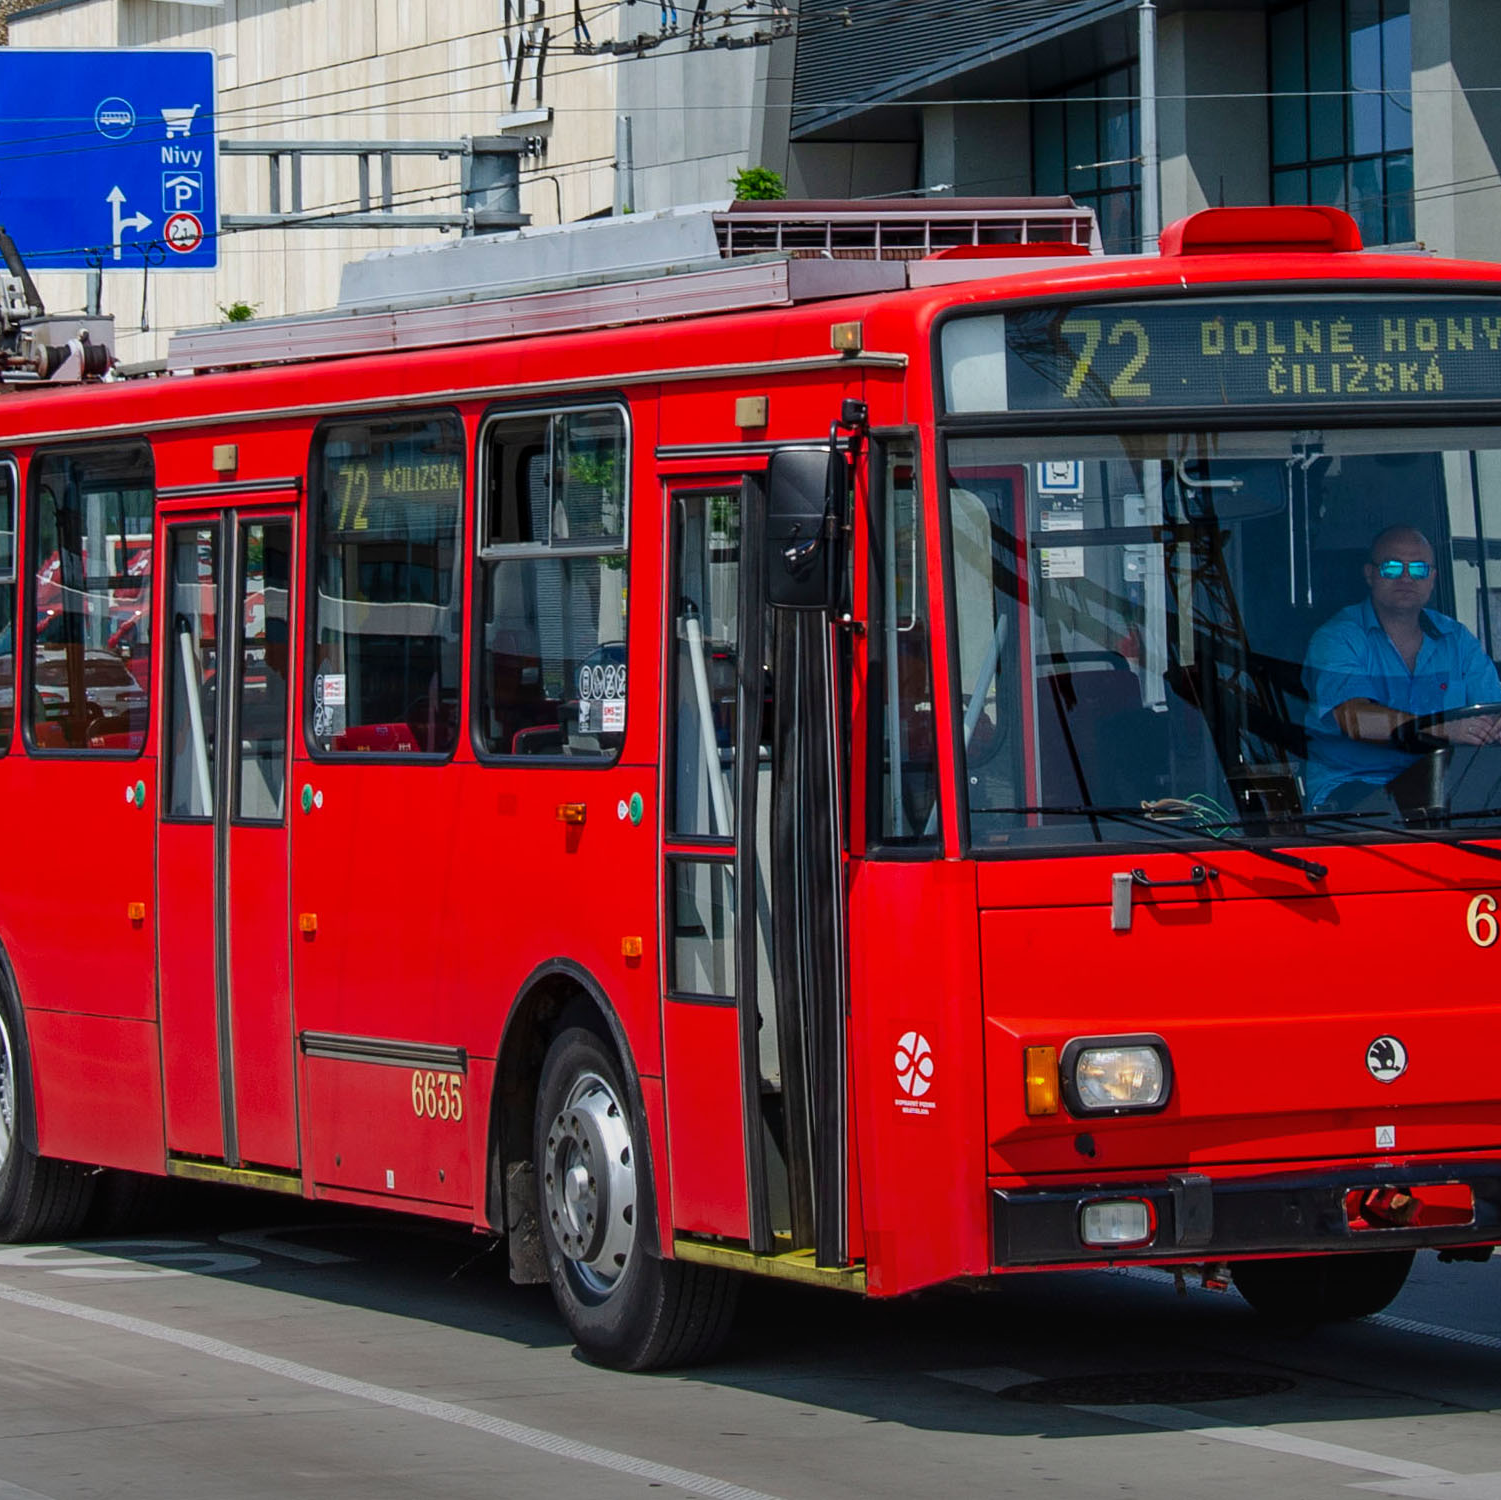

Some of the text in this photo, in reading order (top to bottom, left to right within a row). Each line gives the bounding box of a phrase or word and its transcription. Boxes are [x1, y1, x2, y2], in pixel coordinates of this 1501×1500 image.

[161, 145, 203, 168] Nivy
[175, 184, 193, 210] P
[1057, 319, 1152, 399] 72
[1200, 313, 1353, 356] DOLNÉ
[1266, 354, 1445, 396] ČILIŽSKÁ
[338, 463, 369, 531] 72
[411, 1069, 463, 1121] 6635
